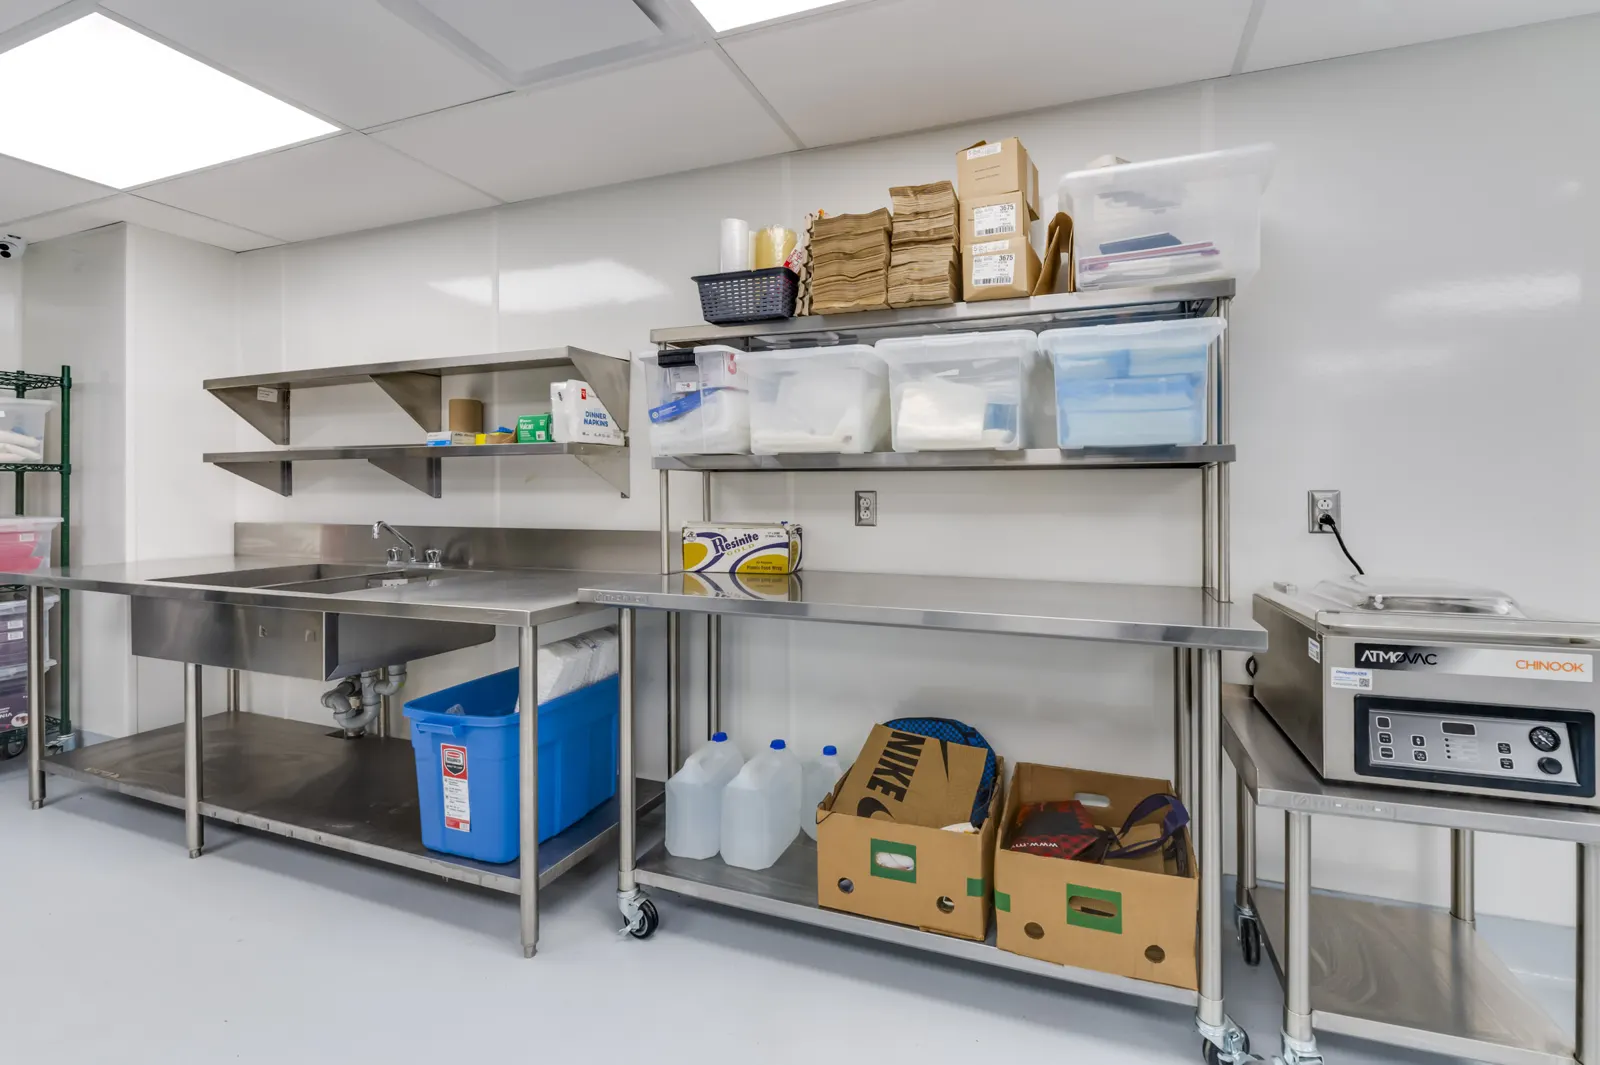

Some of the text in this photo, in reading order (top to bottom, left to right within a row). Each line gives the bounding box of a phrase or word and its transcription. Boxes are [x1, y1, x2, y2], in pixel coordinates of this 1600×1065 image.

[585, 411, 607, 420] DINNER
[583, 418, 609, 427] NAPKINS
[711, 533, 759, 554] Resinite
[726, 543, 755, 556] GOLD
[1515, 659, 1585, 673] CHINOOK
[866, 731, 927, 803] NIKE
